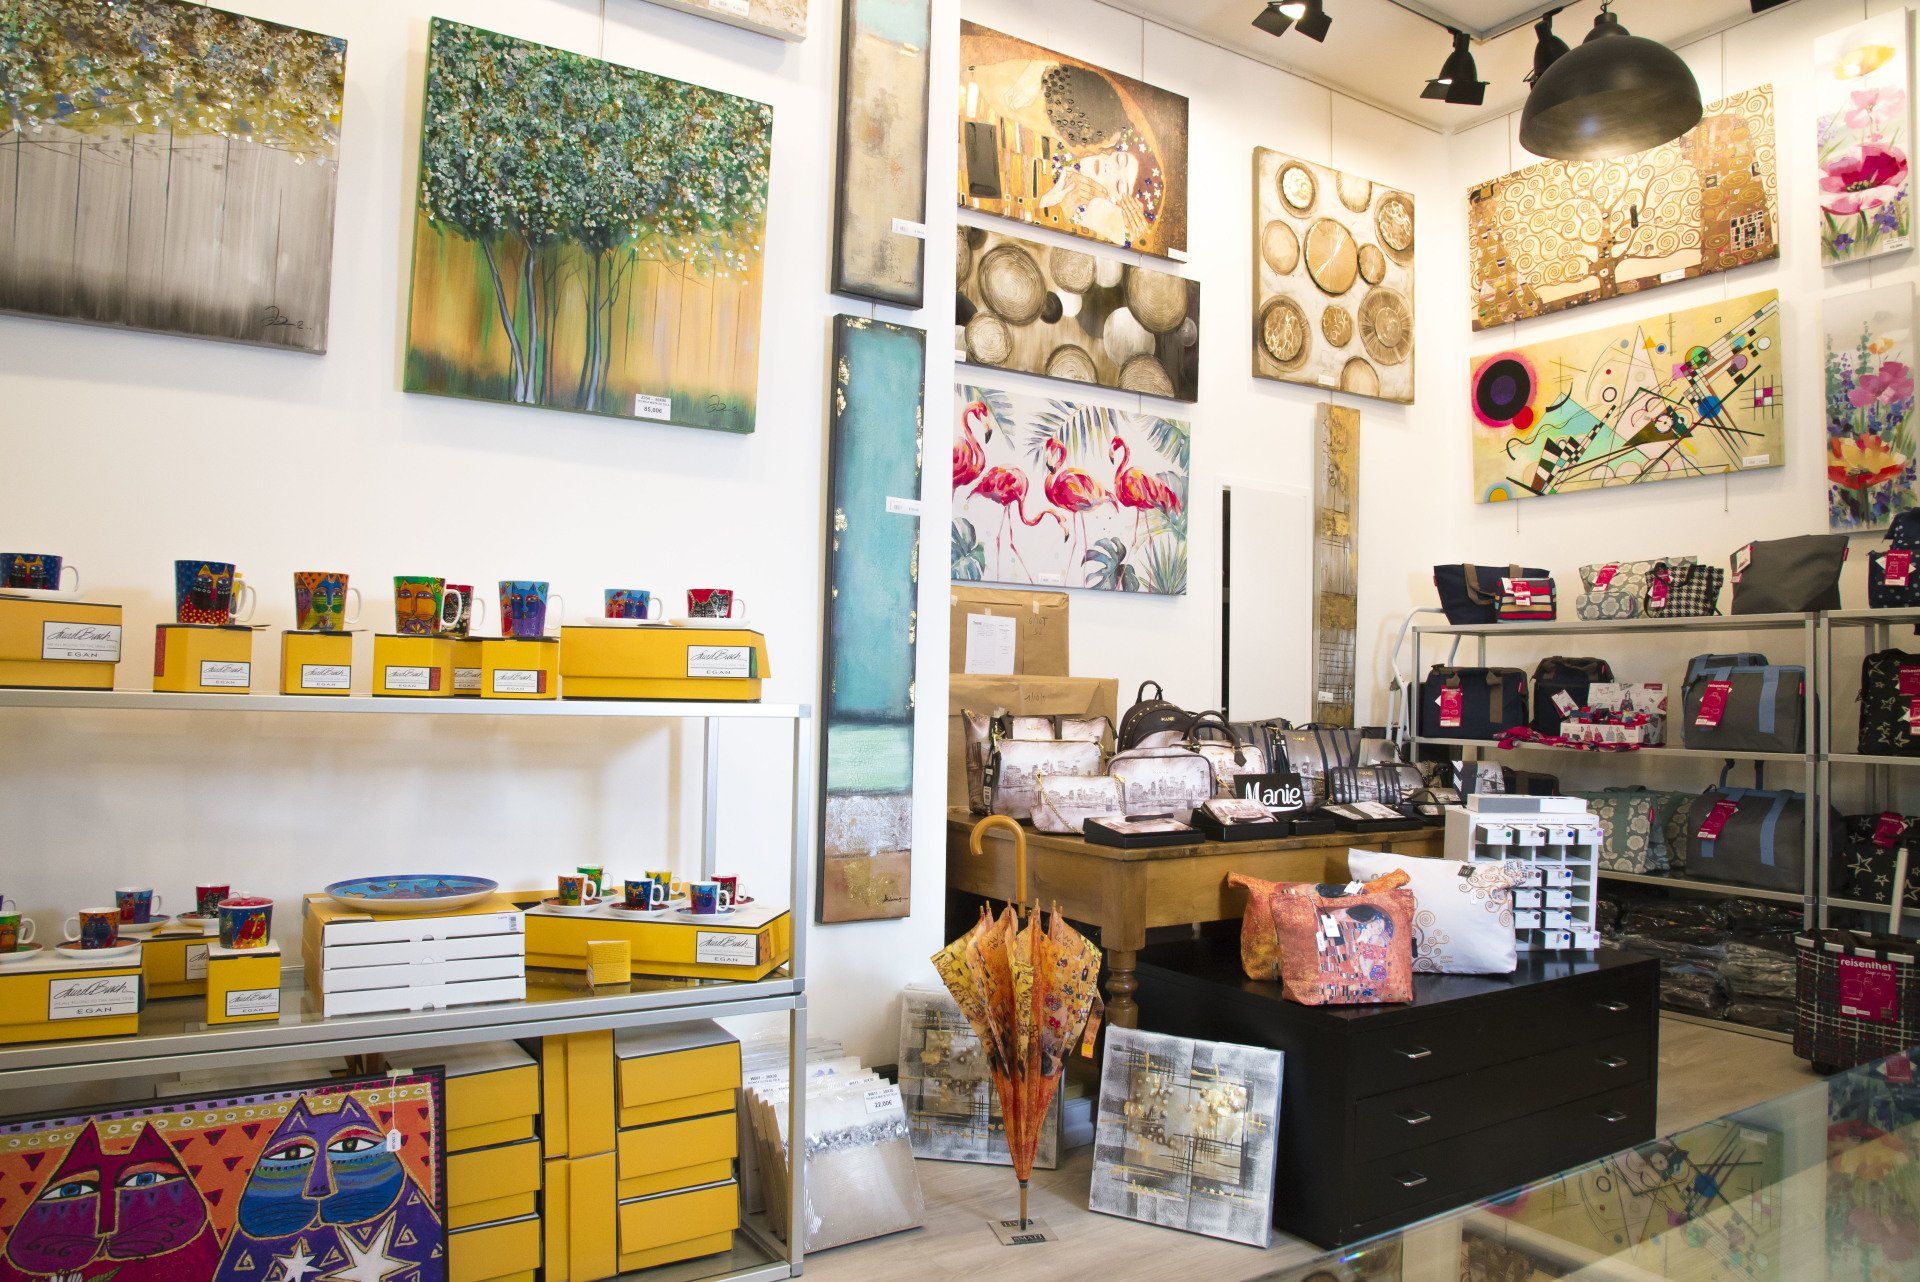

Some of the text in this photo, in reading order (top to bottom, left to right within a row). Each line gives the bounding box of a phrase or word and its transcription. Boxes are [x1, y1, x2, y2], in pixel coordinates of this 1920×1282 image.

[1245, 780, 1303, 812] Manie
[1840, 958, 1892, 971] reisenthel
[77, 1006, 112, 1015] EGAN
